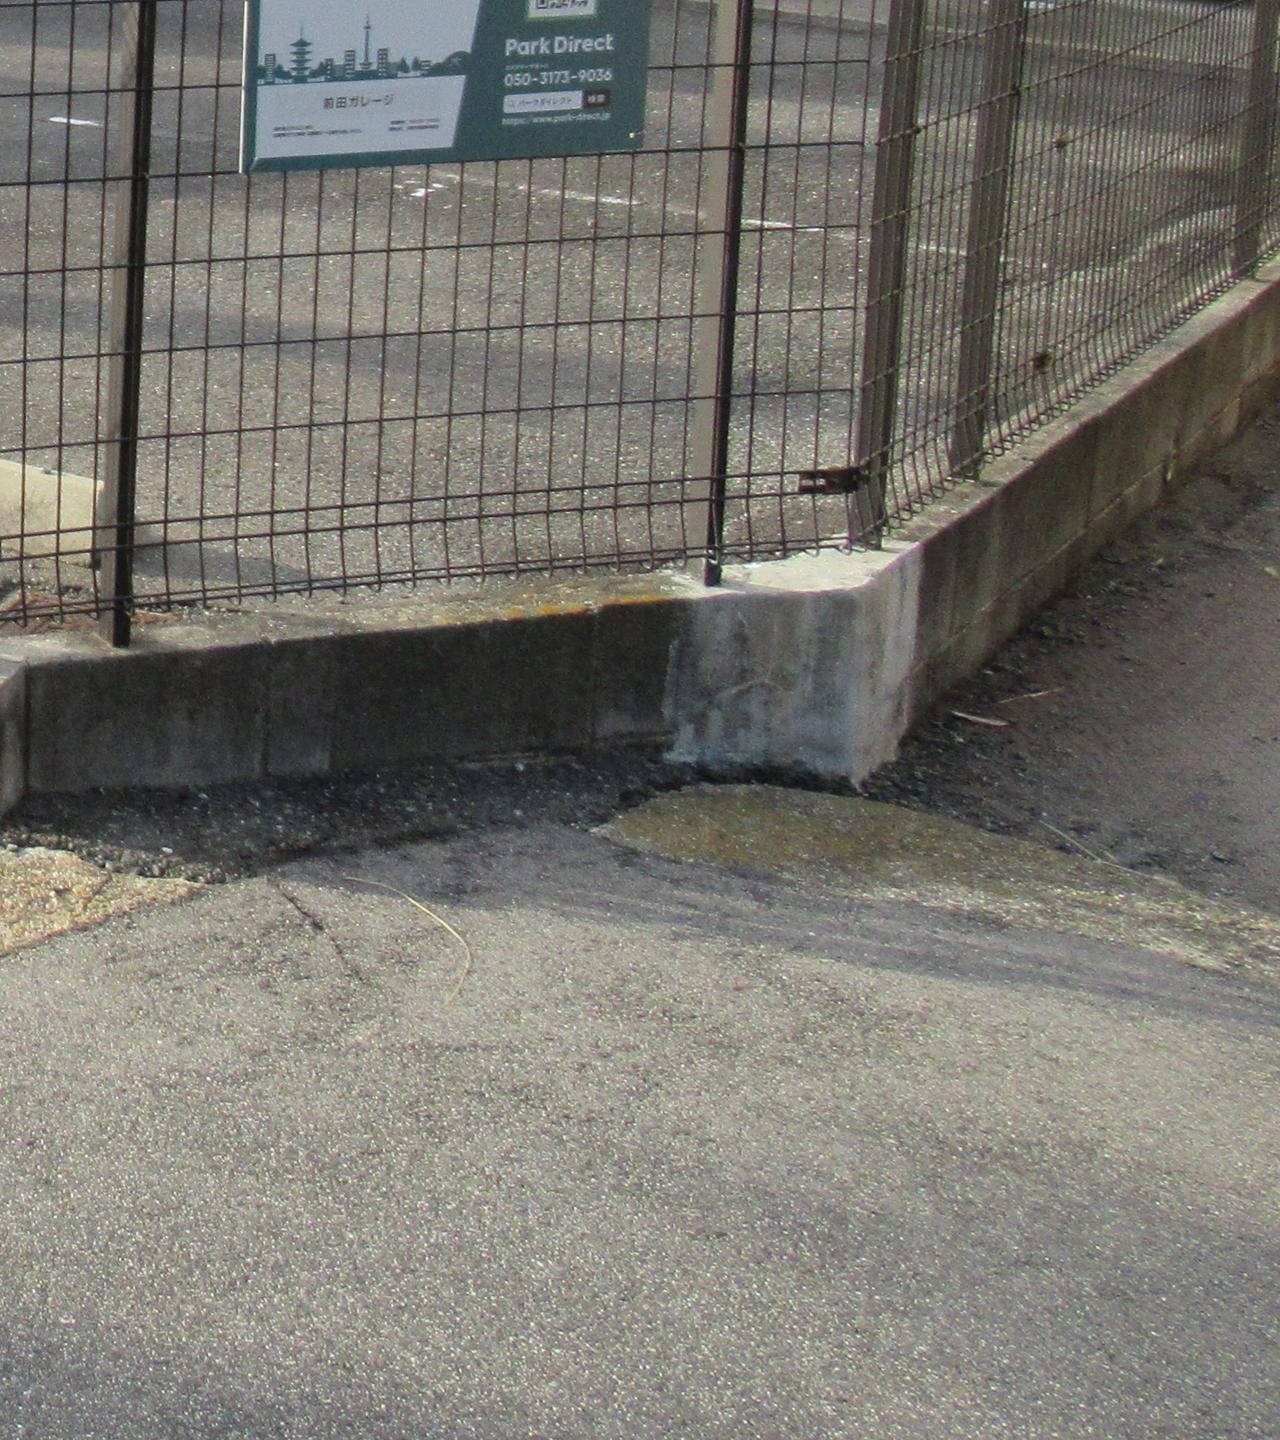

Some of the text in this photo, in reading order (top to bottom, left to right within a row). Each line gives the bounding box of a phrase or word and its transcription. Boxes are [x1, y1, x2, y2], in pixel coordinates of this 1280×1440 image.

[504, 33, 615, 56] Park Direct
[504, 68, 613, 86] 050-3173-9036
[322, 93, 394, 110] 前田ガレージ
